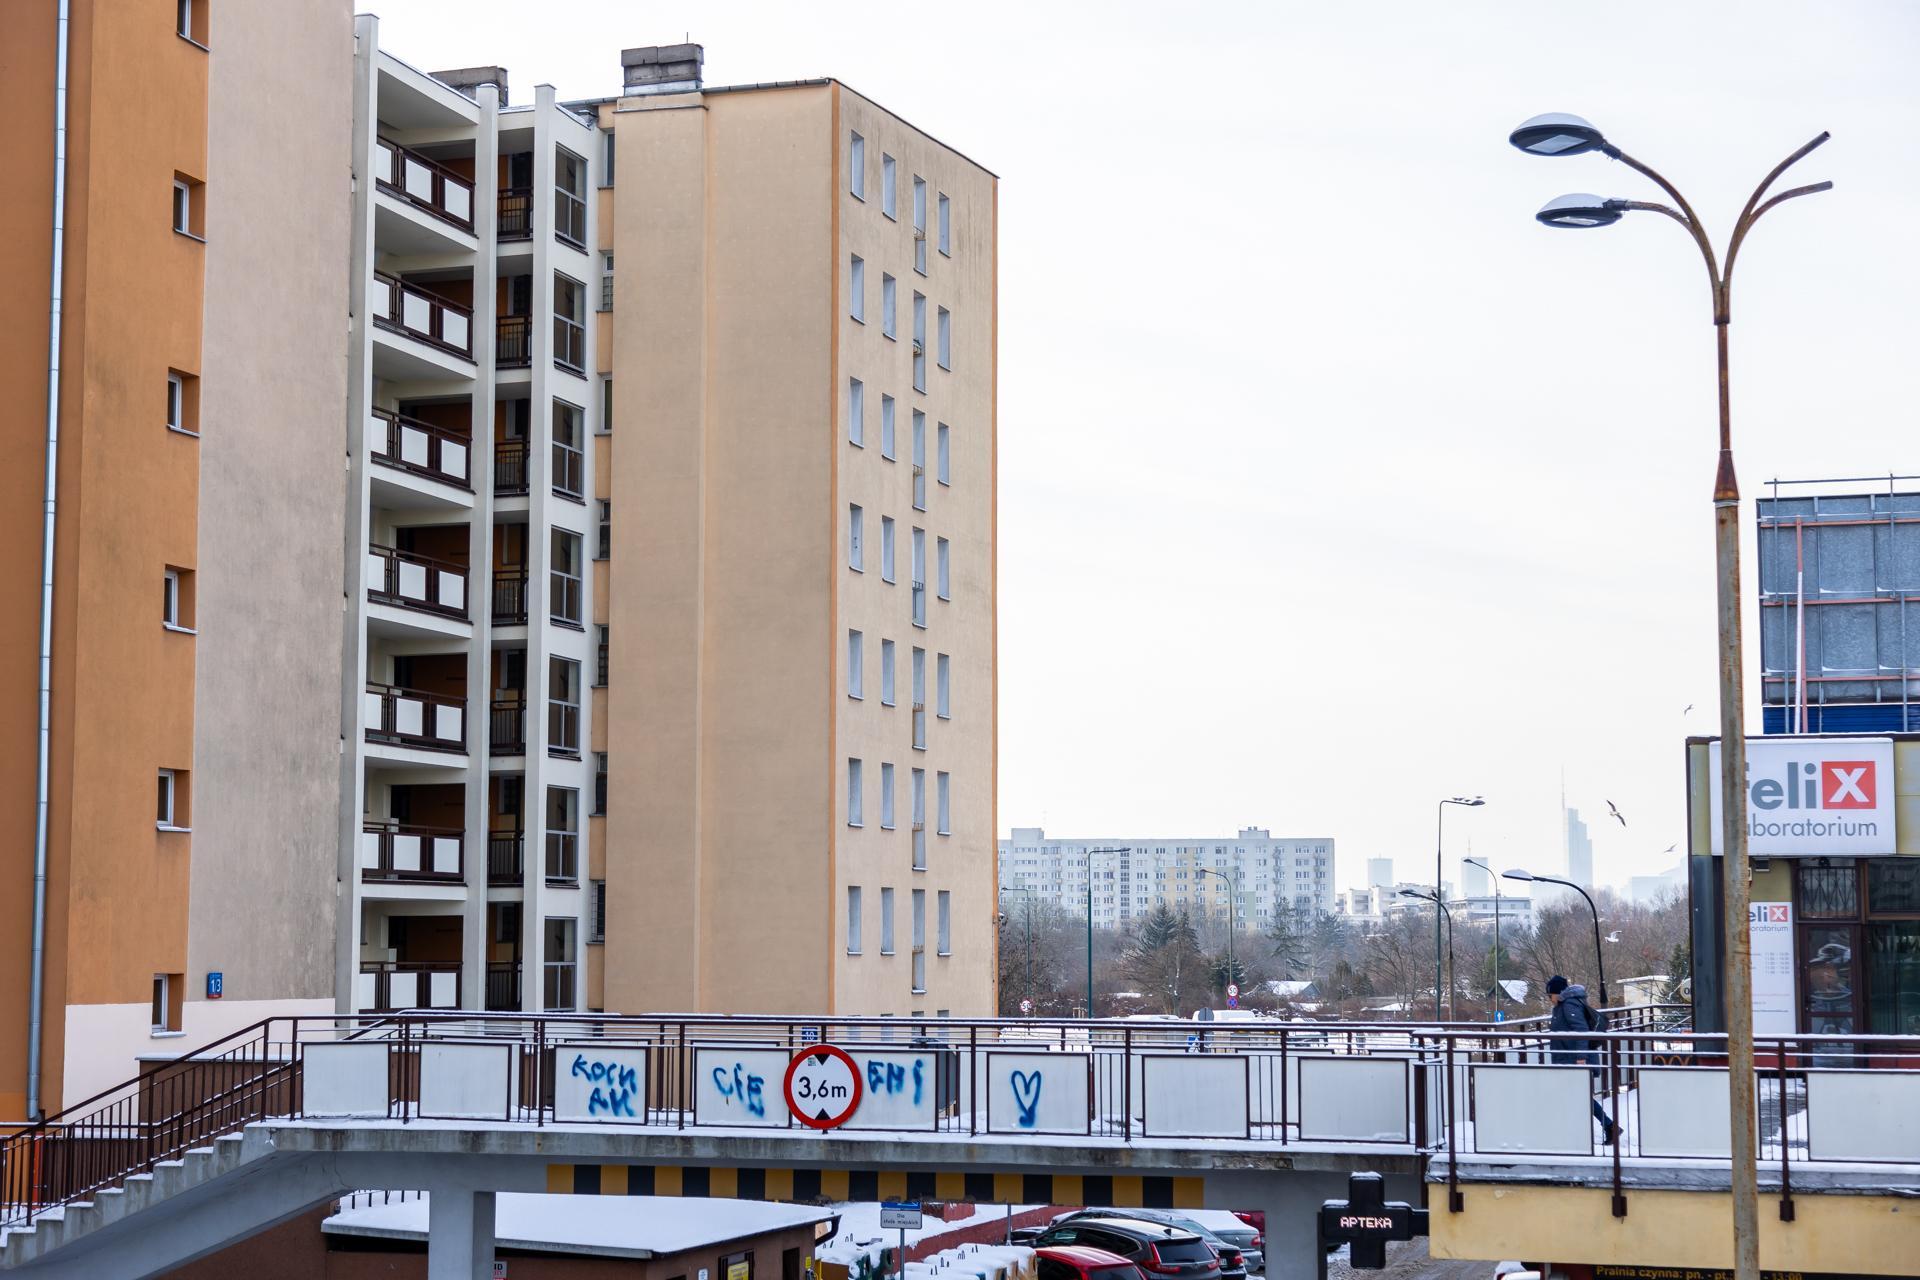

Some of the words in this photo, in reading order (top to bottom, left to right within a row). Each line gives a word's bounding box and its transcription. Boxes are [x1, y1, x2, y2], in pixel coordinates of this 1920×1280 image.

[1748, 813, 1877, 836] boratorium
[1340, 1216, 1392, 1229] APTEKA
[1596, 1265, 1636, 1277] Pralnia
